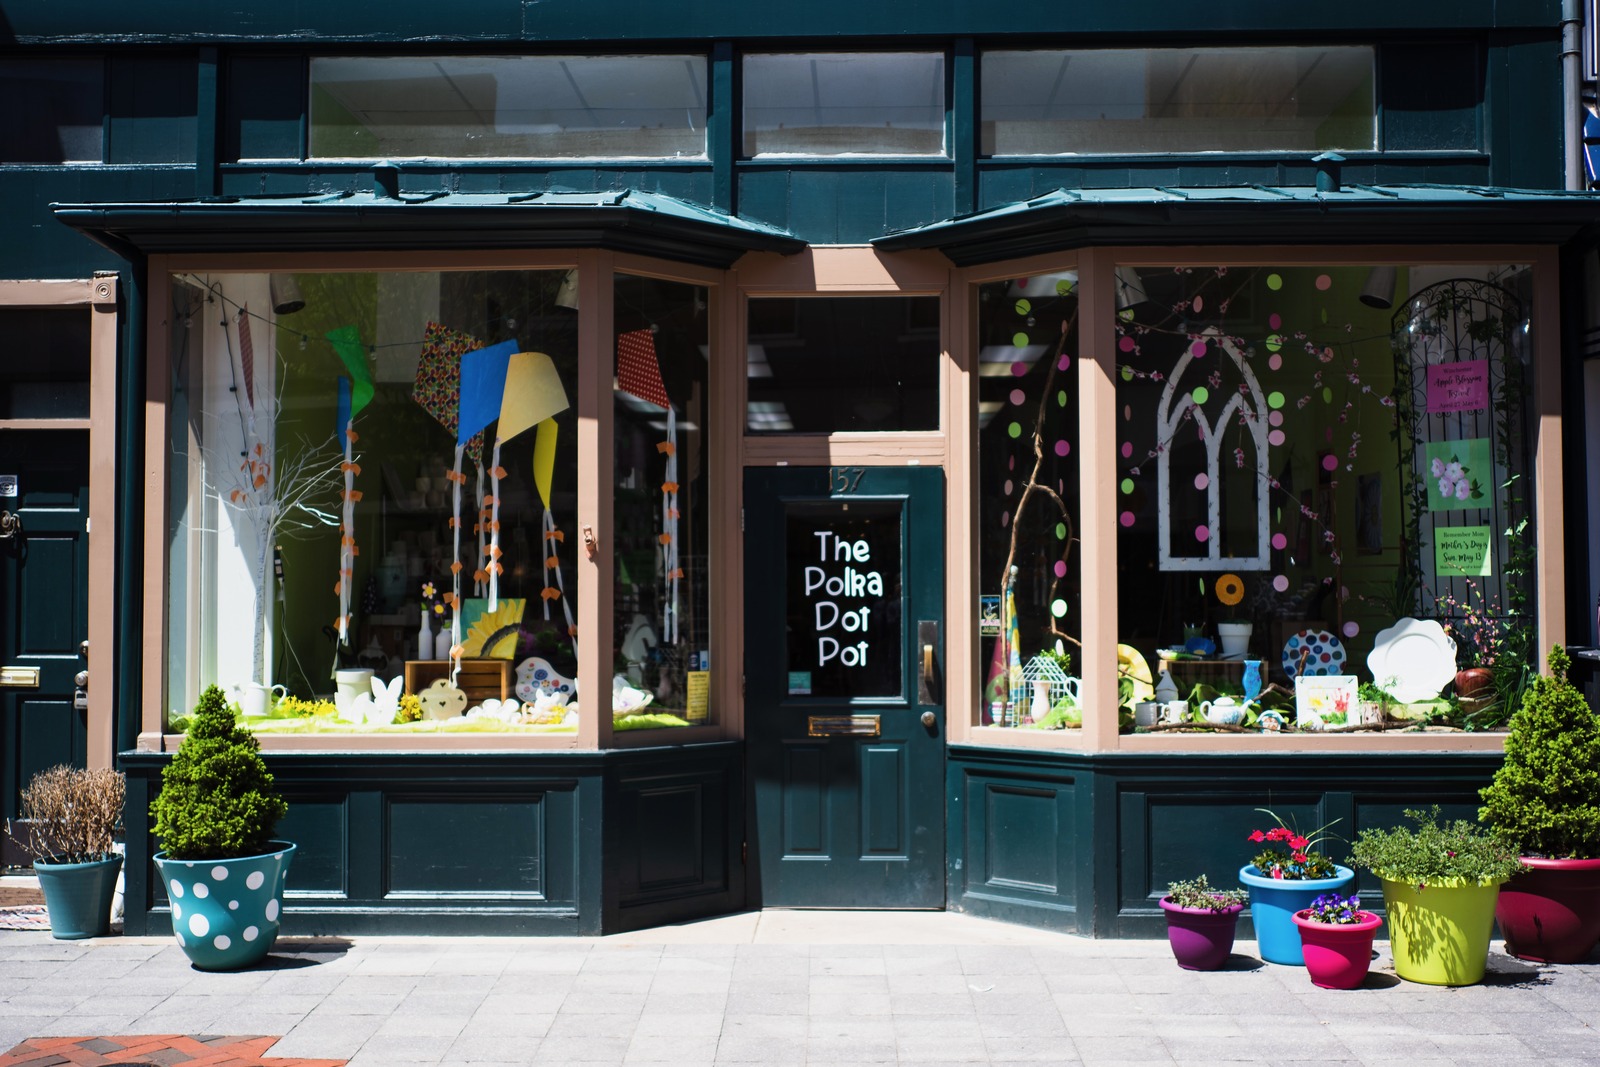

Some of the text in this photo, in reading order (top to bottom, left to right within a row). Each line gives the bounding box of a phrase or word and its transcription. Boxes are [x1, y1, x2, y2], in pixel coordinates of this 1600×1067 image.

[1434, 374, 1482, 388] Apple Blossom
[828, 468, 865, 492] 157
[814, 531, 870, 562] The
[1441, 540, 1469, 549] Mother's
[1470, 540, 1482, 550] Day
[1458, 554, 1474, 563] May
[1475, 552, 1482, 561] 13
[804, 566, 883, 597] Polka
[815, 601, 871, 632] Dot
[818, 636, 869, 667] Pot
